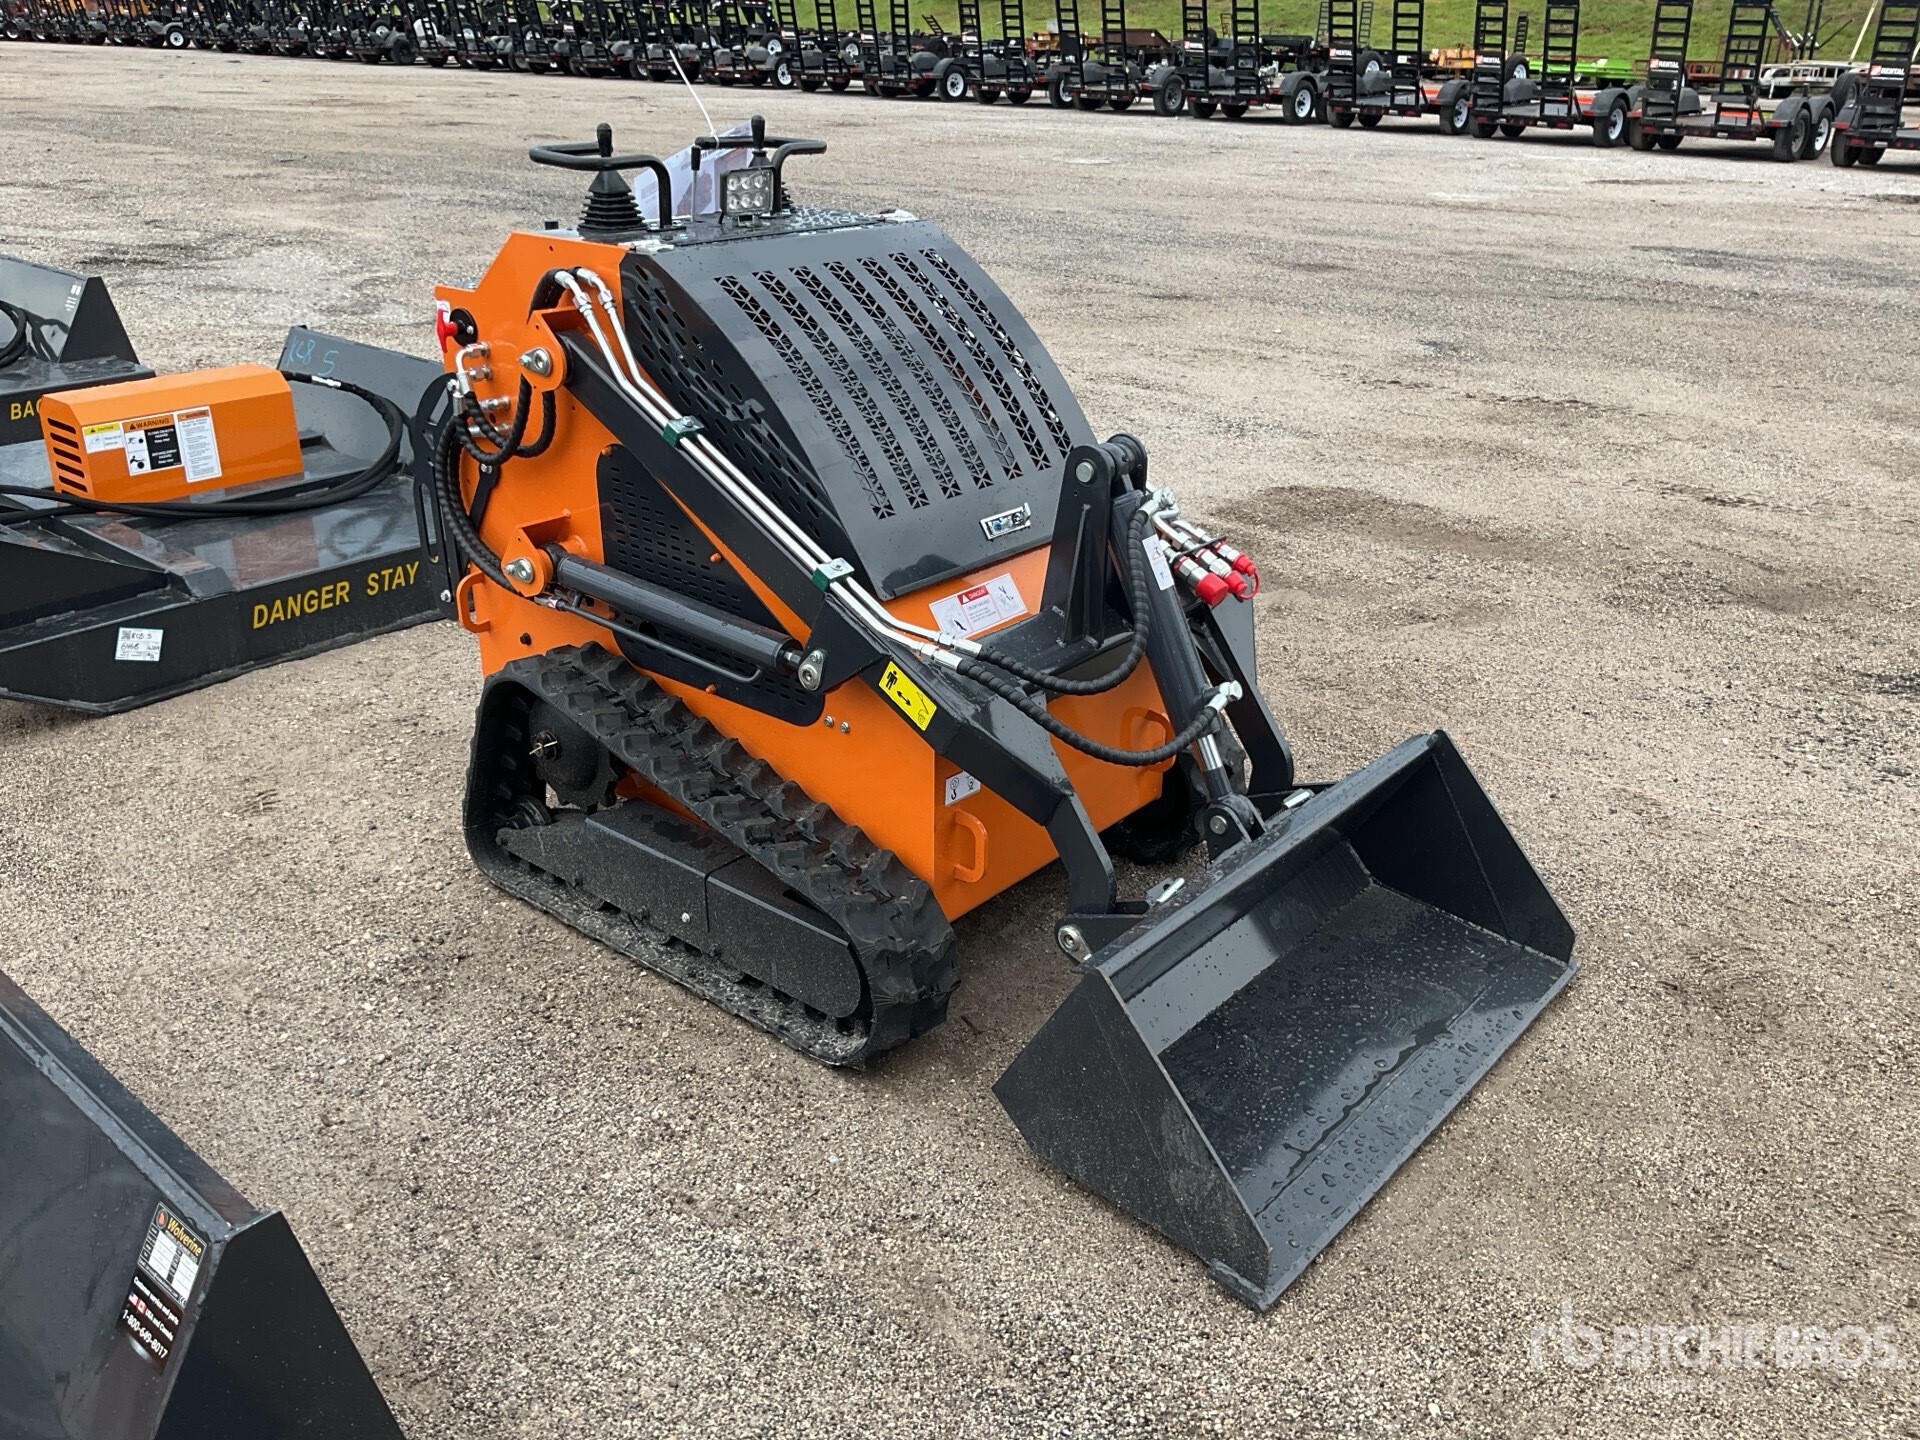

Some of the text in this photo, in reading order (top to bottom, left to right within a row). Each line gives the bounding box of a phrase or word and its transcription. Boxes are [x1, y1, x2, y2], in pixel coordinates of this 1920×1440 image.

[1658, 60, 1679, 69] RENTAL
[1881, 67, 1905, 75] RENTAL
[136, 417, 170, 429] WARNING
[253, 561, 419, 629] DANGER STAY
[167, 1217, 202, 1256] Wolverine
[122, 1309, 168, 1358] 1-800-649-8017
